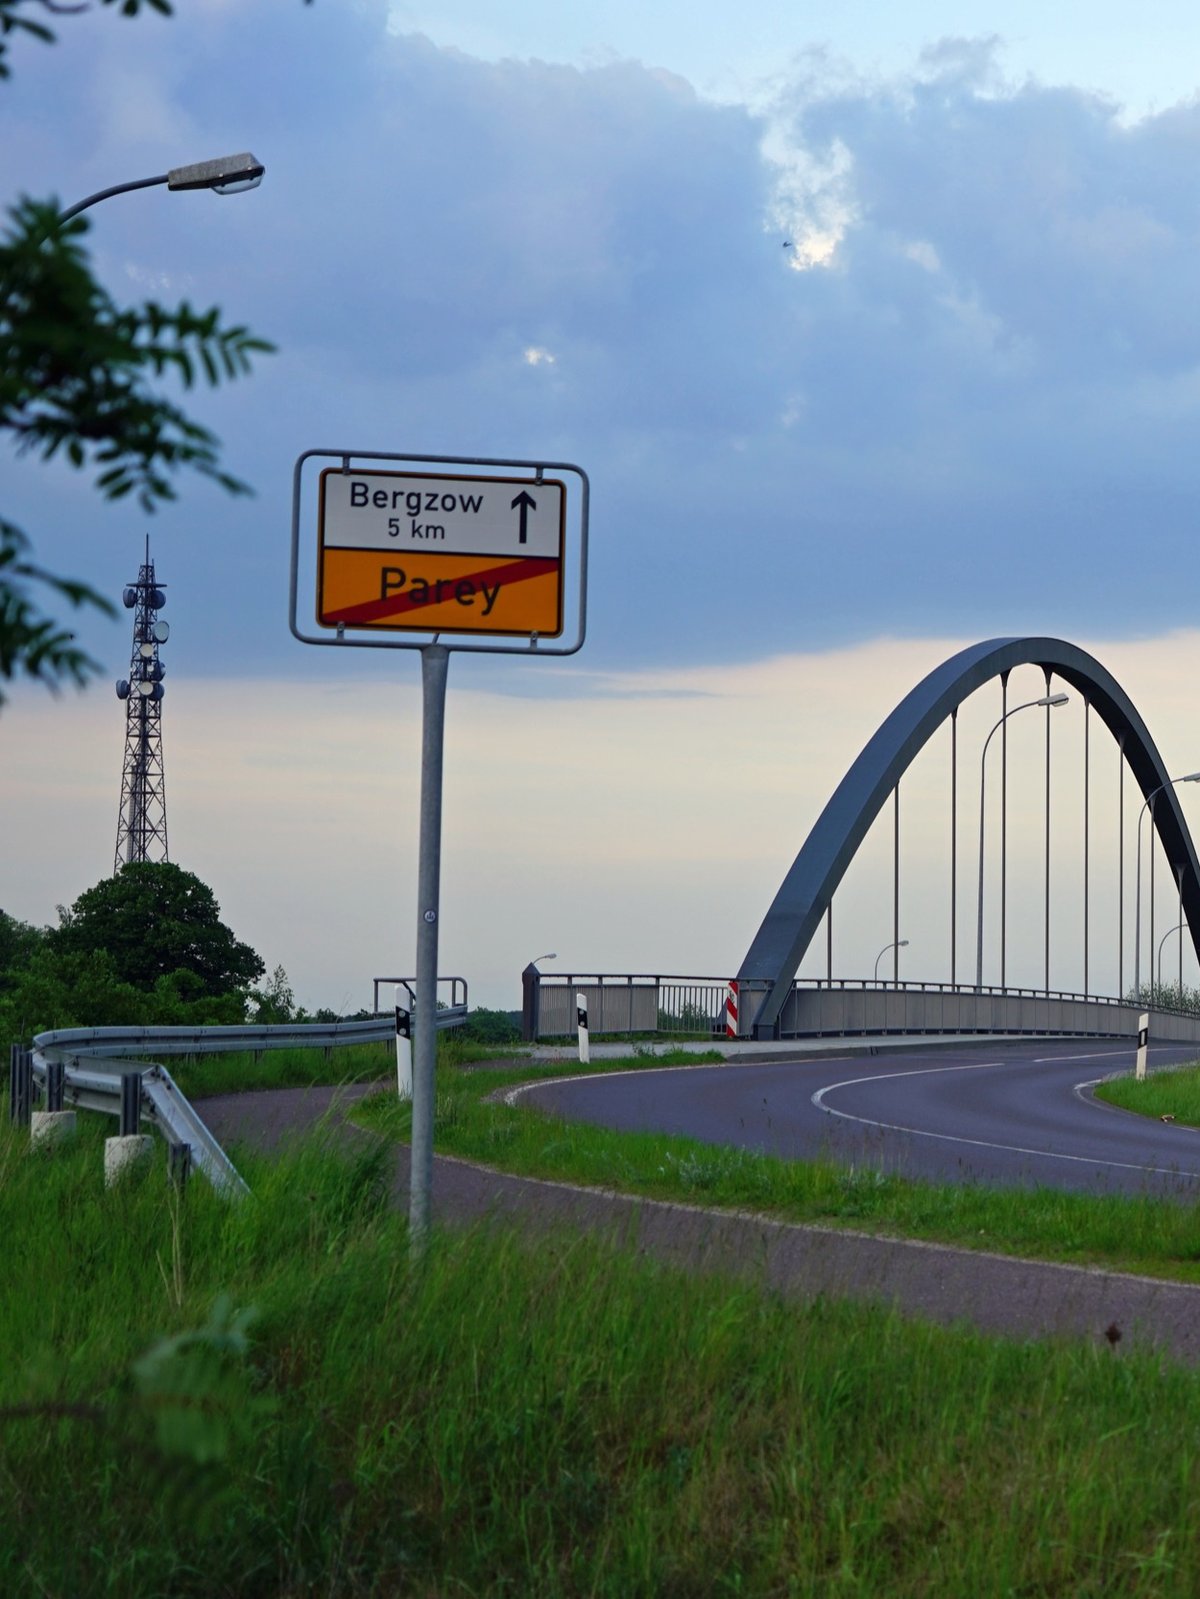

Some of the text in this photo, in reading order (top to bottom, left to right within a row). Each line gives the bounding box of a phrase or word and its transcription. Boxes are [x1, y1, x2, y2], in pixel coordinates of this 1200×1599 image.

[350, 482, 483, 517] Bergzow
[388, 518, 445, 540] 5 km
[380, 566, 501, 616] Parey
